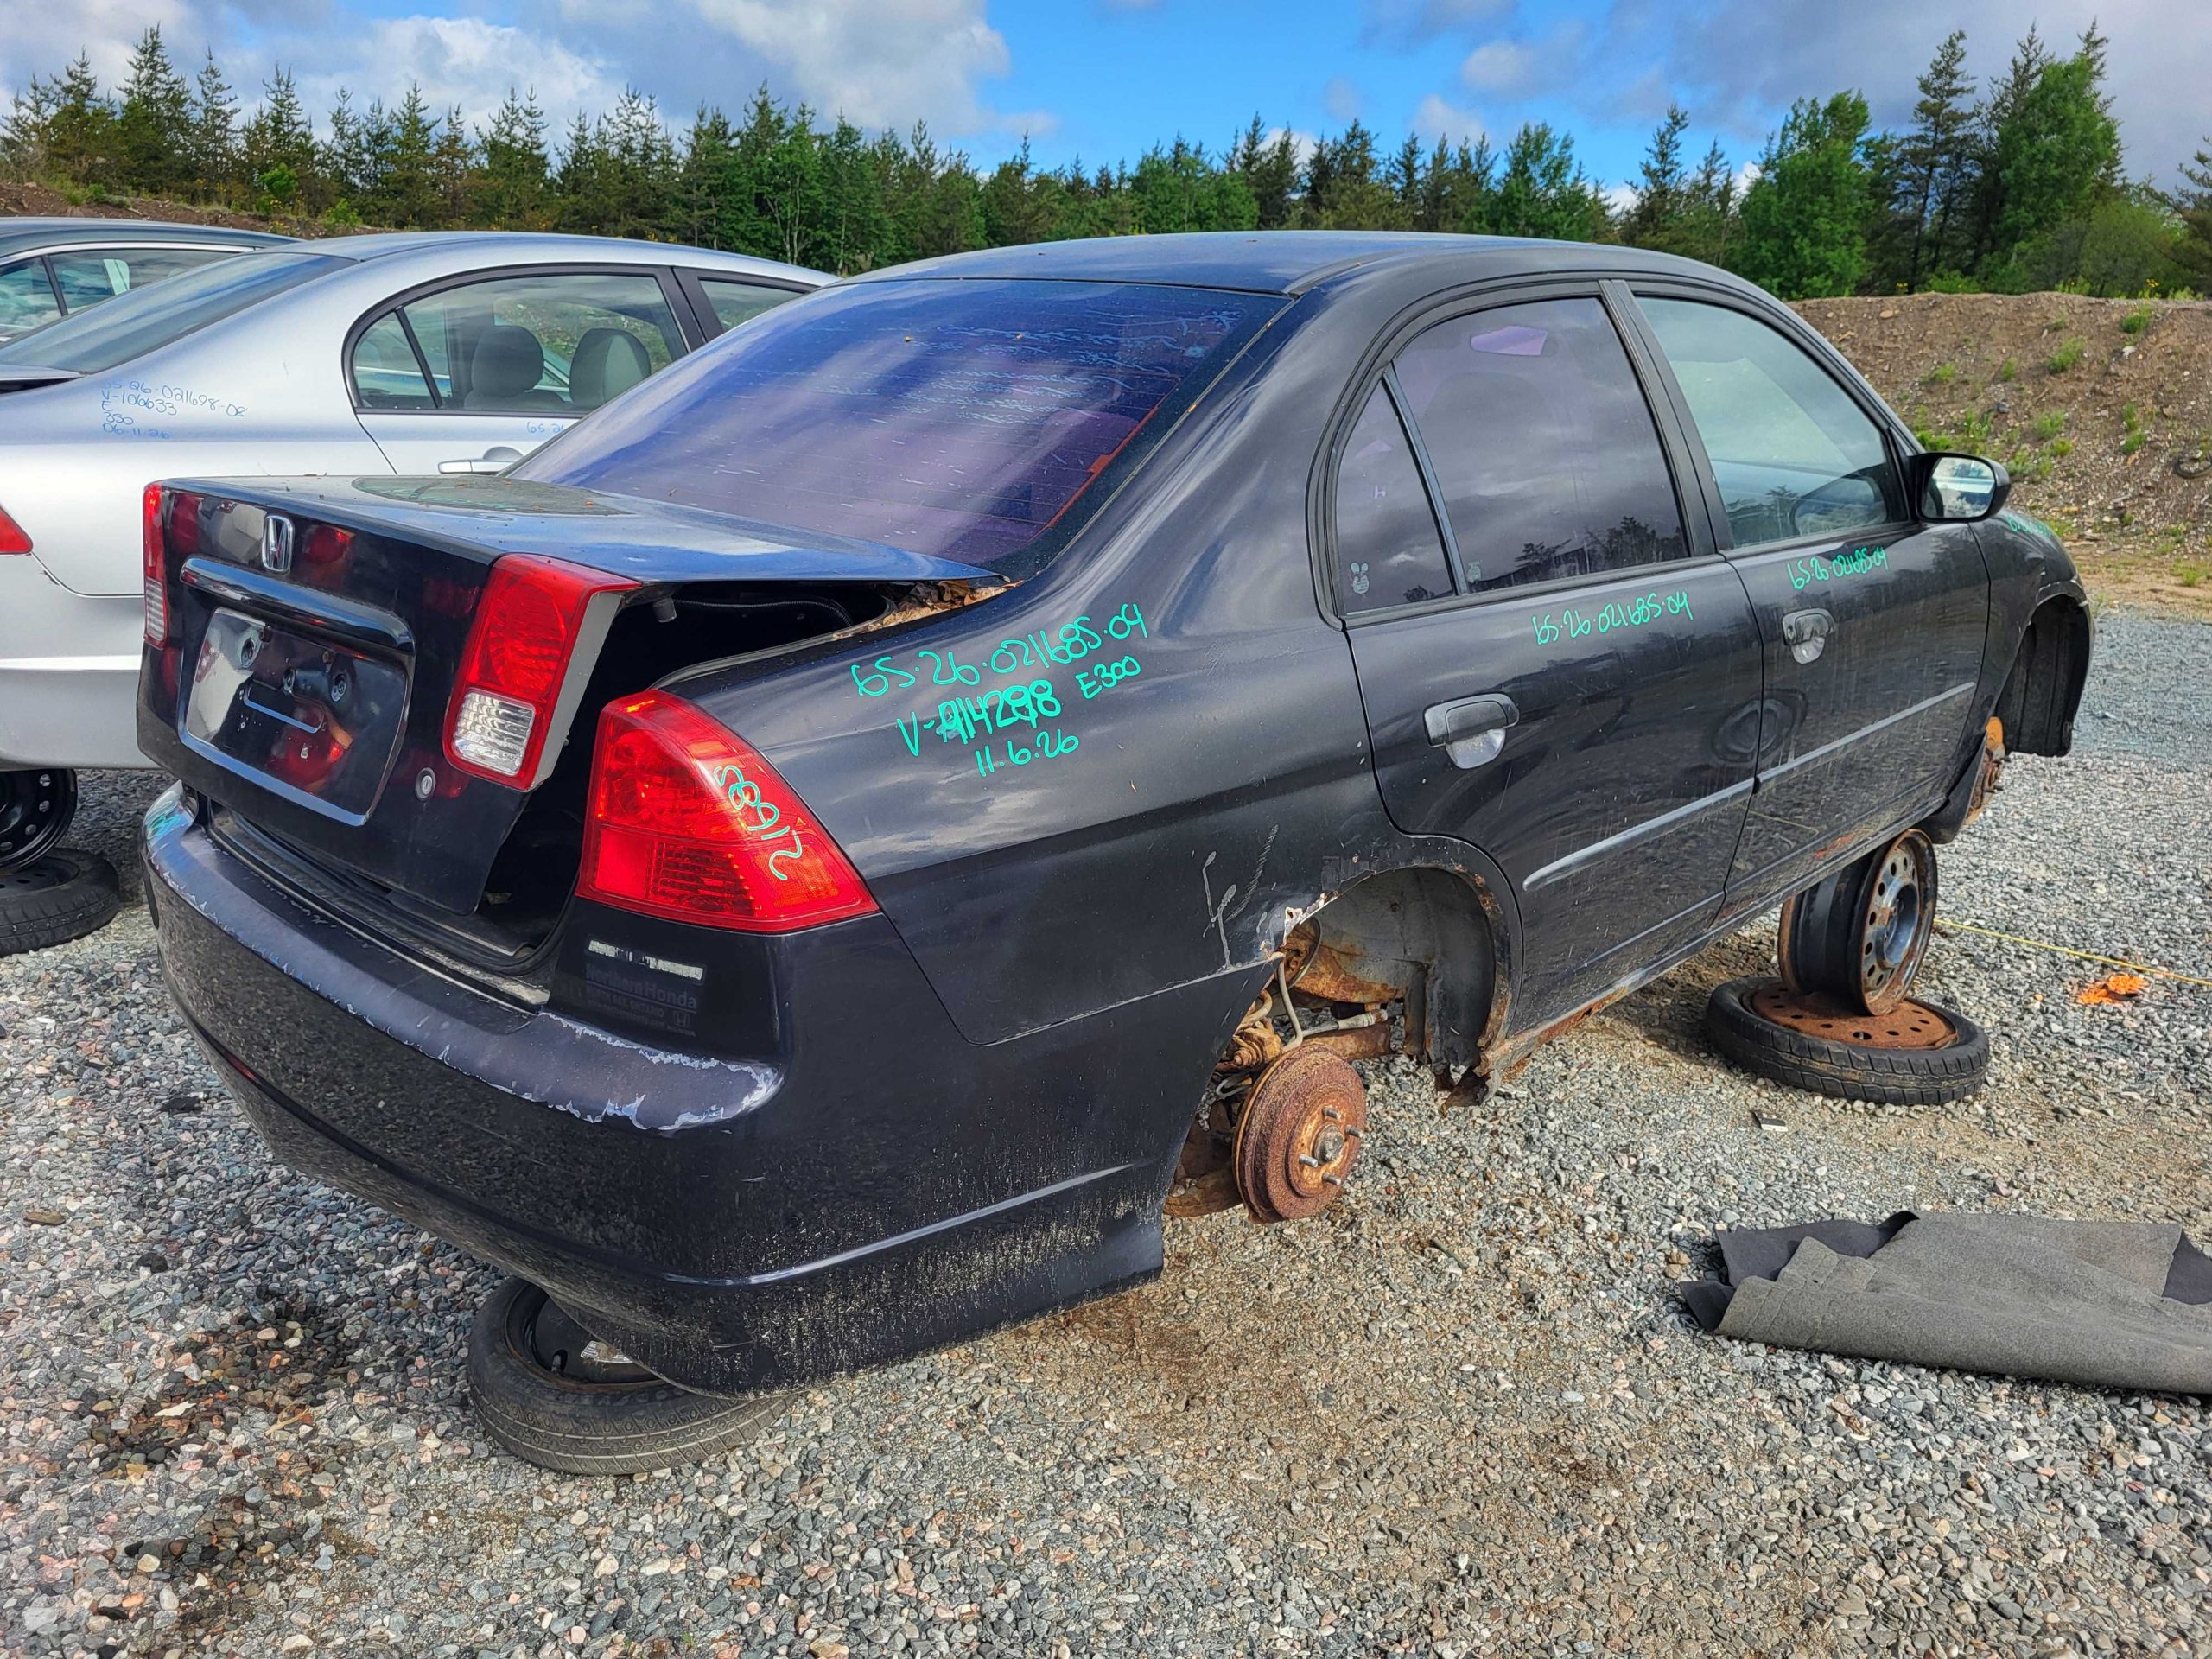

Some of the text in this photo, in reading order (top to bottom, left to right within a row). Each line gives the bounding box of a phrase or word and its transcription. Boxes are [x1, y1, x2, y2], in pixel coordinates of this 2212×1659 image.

[103, 411, 134, 425] 350
[1074, 654, 1142, 701] E300
[645, 982, 697, 1009] Honda
